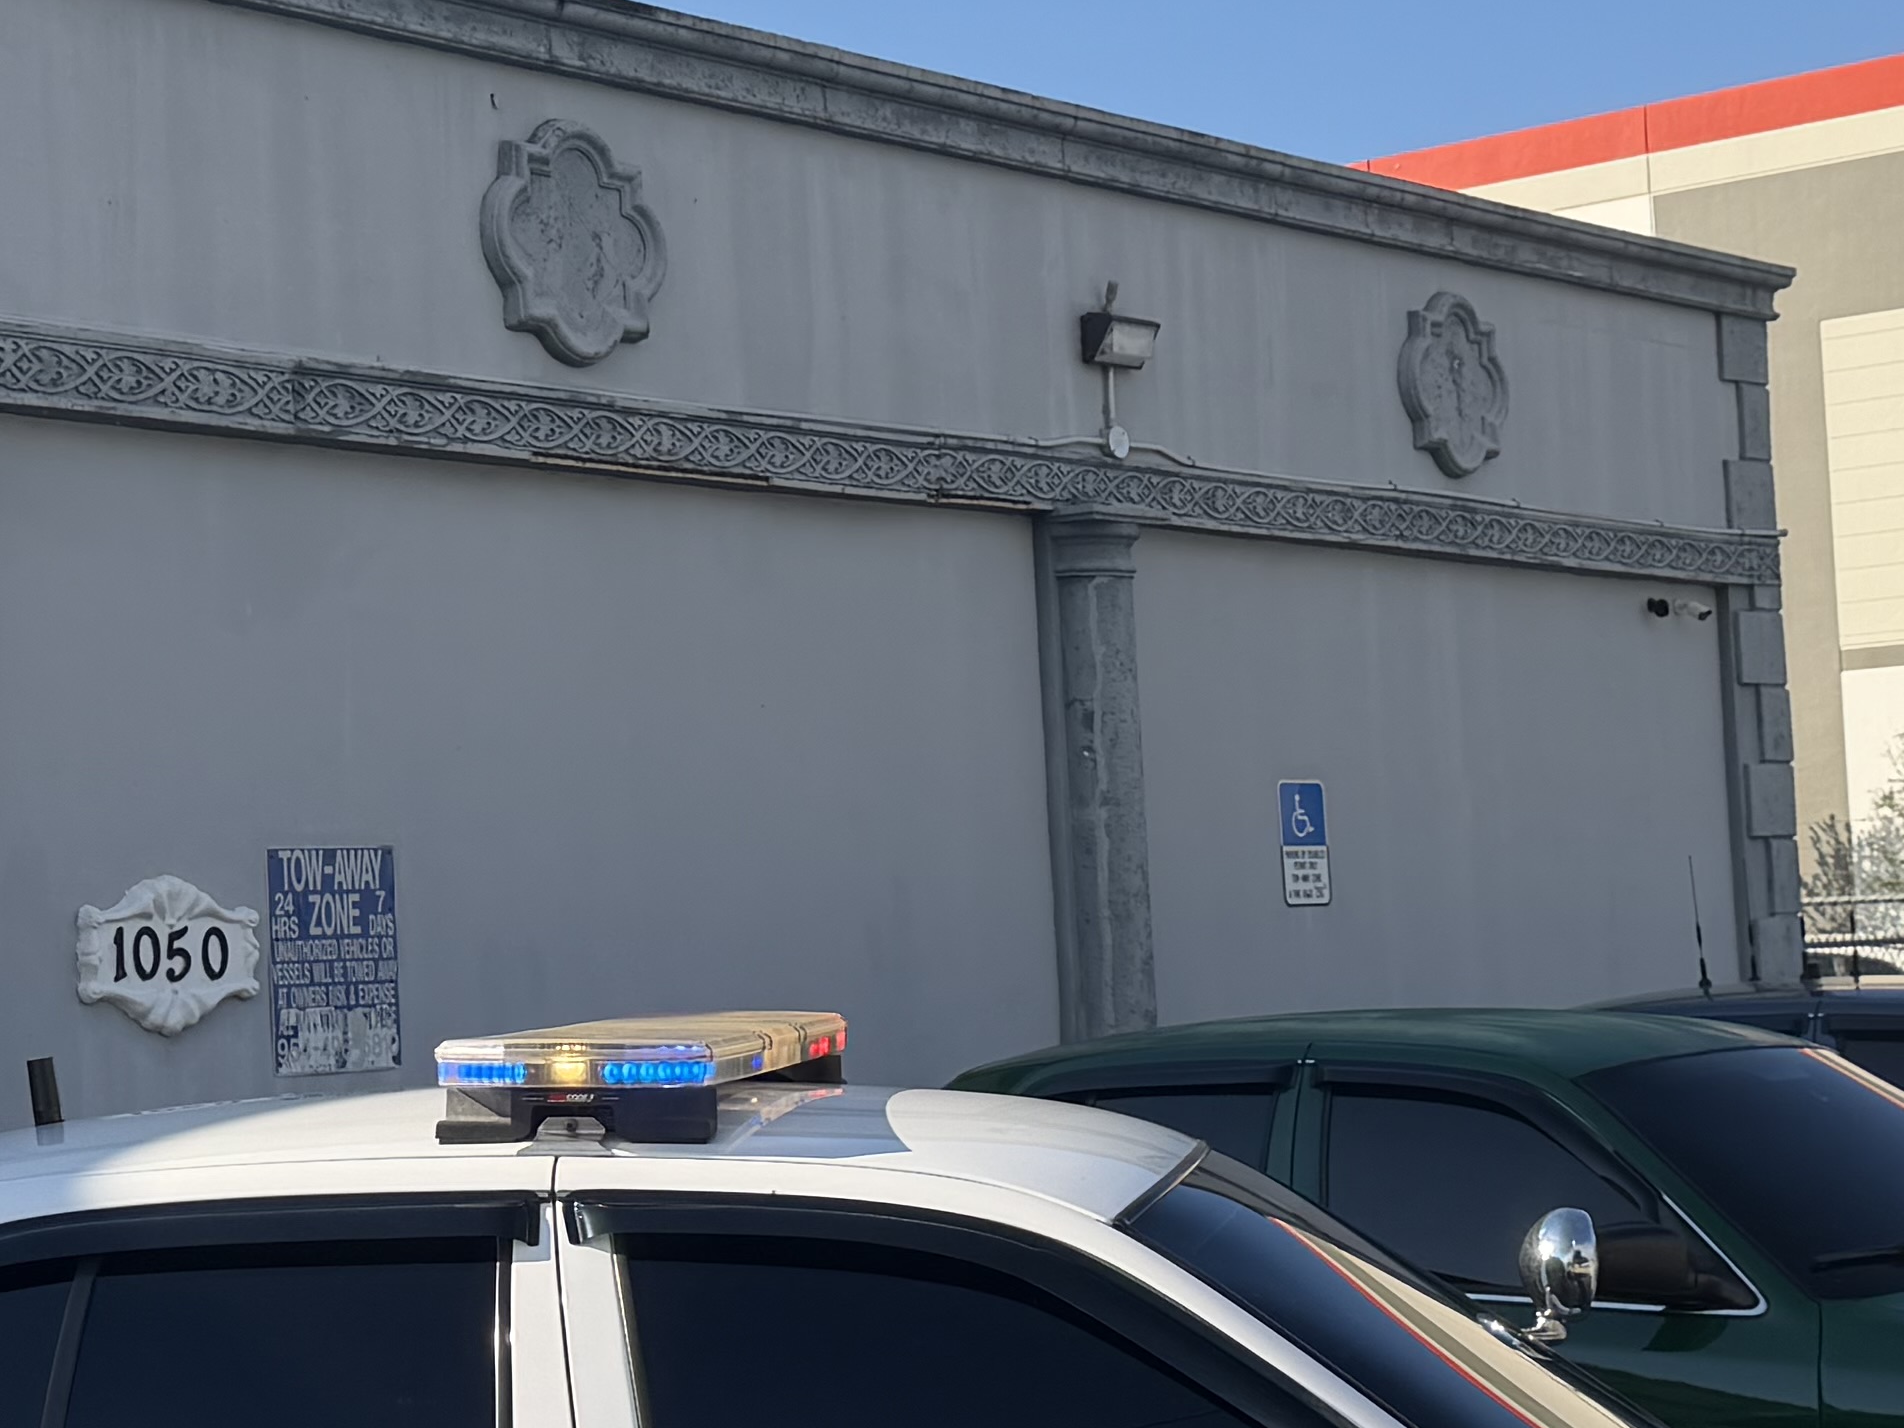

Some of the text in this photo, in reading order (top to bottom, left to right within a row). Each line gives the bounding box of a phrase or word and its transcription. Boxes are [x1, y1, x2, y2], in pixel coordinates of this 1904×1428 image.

[277, 849, 382, 892] TOW-AWAY
[274, 892, 295, 915] 24
[375, 890, 386, 913] 7
[308, 892, 362, 936] ZONE
[368, 913, 395, 936] DAYS
[271, 915, 299, 939] HRS
[112, 926, 229, 983] 1050
[274, 937, 395, 962] UNAUTHORIZED VEHICLES OR
[272, 962, 311, 984] VESSELS
